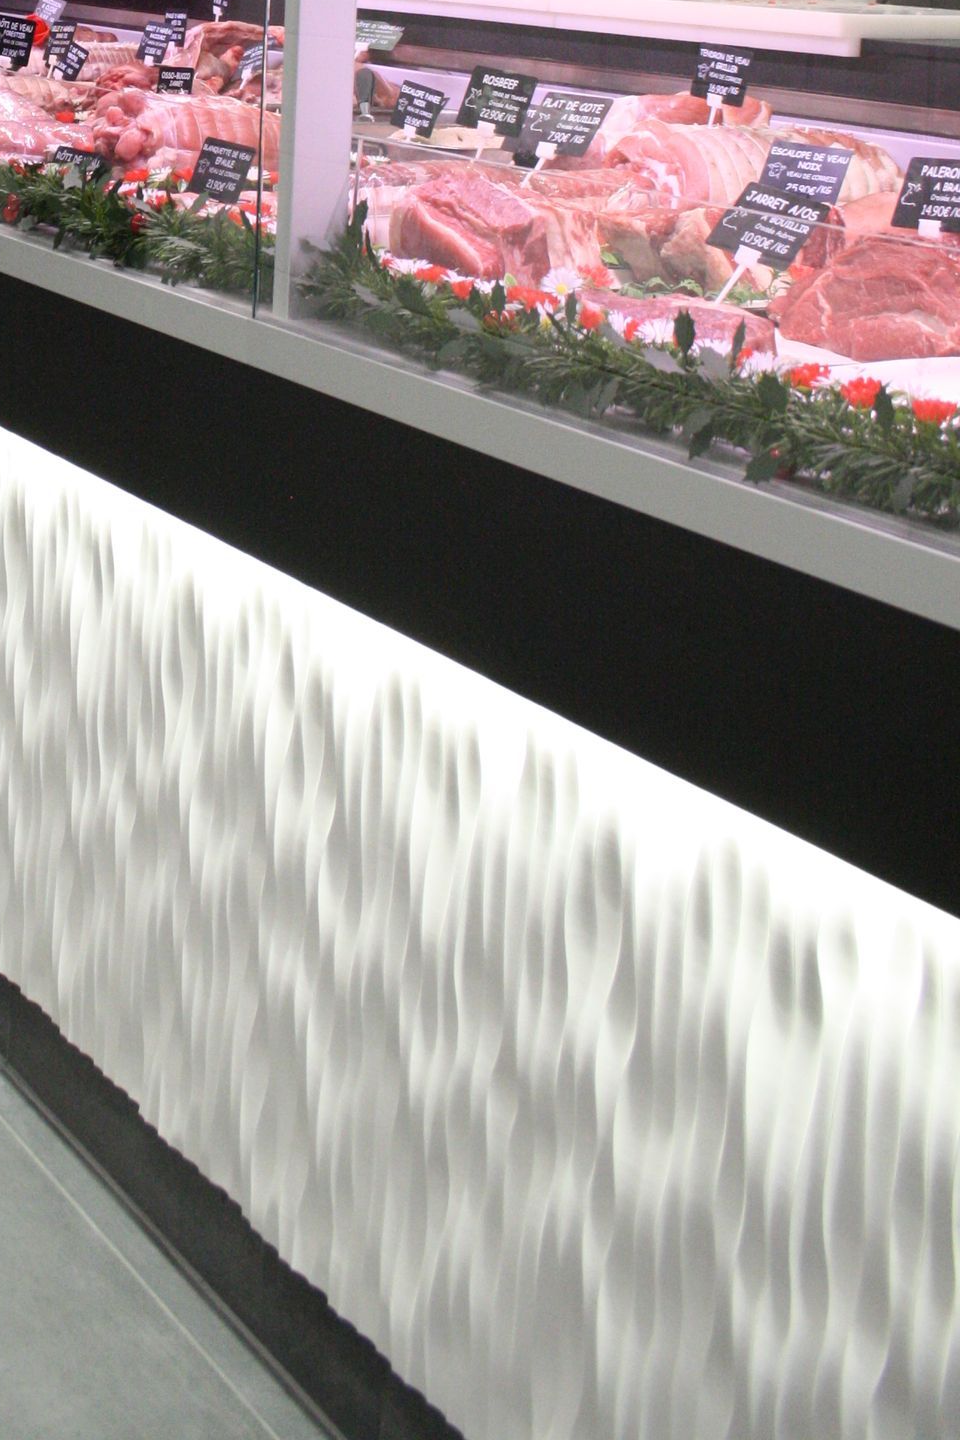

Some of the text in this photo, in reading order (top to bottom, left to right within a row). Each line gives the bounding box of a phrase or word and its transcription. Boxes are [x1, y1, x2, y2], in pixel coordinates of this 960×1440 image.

[11, 22, 19, 31] DE
[19, 23, 33, 33] VEAU
[700, 48, 750, 66] TENDRON DE VEAU
[482, 74, 519, 90] ROSBEEF
[542, 97, 605, 114] PLAT DE COTE
[568, 114, 601, 125] BOUILLIR
[55, 150, 73, 162] RÔTI
[231, 150, 239, 158] DE
[239, 152, 252, 161] VEAU
[771, 146, 849, 165] ESCALOPE DE VEAU
[214, 156, 236, 169] EPAULE
[797, 160, 822, 172] NOIX
[933, 182, 941, 191] A
[745, 190, 820, 221] JARRET A/OS
[768, 215, 810, 235] BOUILLIR
